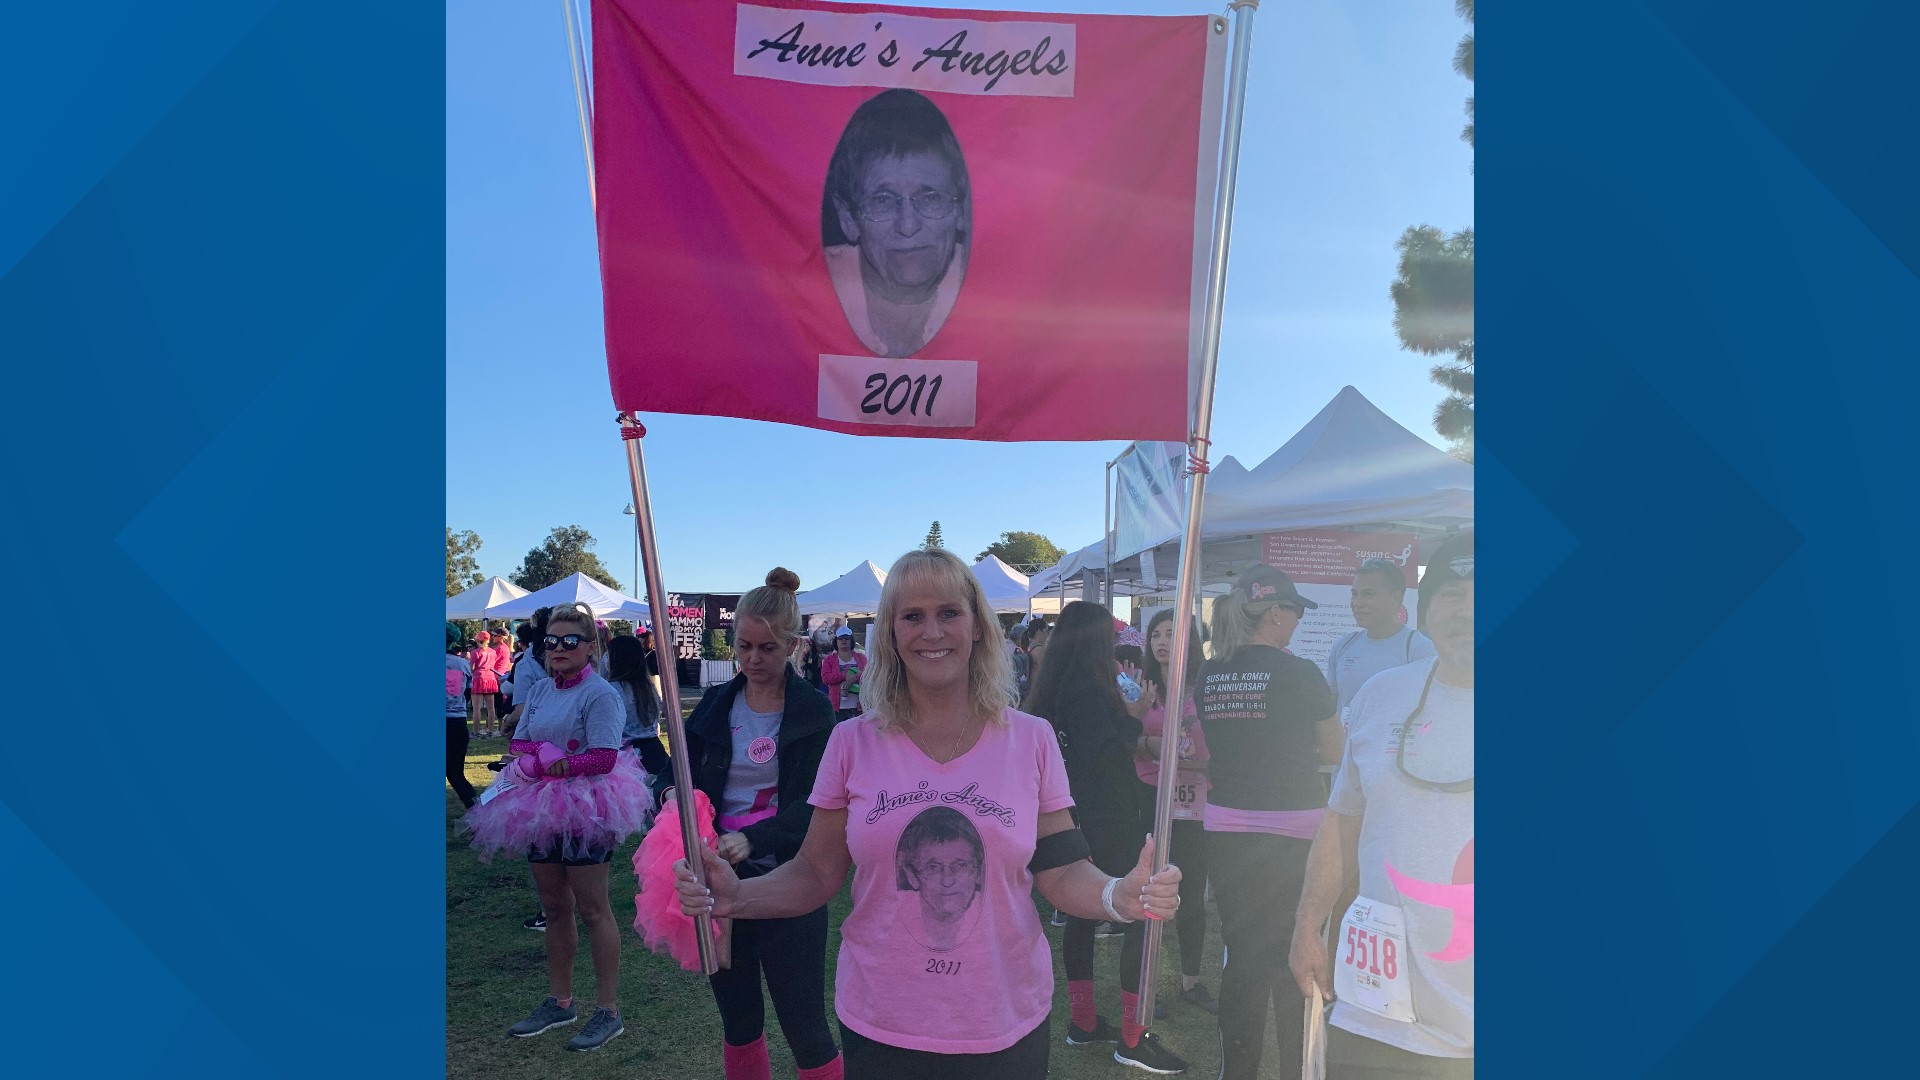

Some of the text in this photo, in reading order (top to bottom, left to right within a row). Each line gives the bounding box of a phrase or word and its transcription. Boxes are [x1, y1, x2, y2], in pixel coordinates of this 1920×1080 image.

[747, 21, 1068, 92] Anne's Angels
[861, 372, 943, 417] 2011
[1355, 550, 1383, 559] susan
[1206, 673, 1231, 684] SUSAN
[1241, 672, 1271, 681] KOMEN
[1216, 682, 1268, 693] ANNIVERSARY
[1227, 702, 1244, 710] PARK
[753, 743, 772, 756] CURE
[865, 780, 1016, 828] Anne's Angels
[1345, 925, 1398, 980] 5518
[925, 958, 962, 976] 2011
